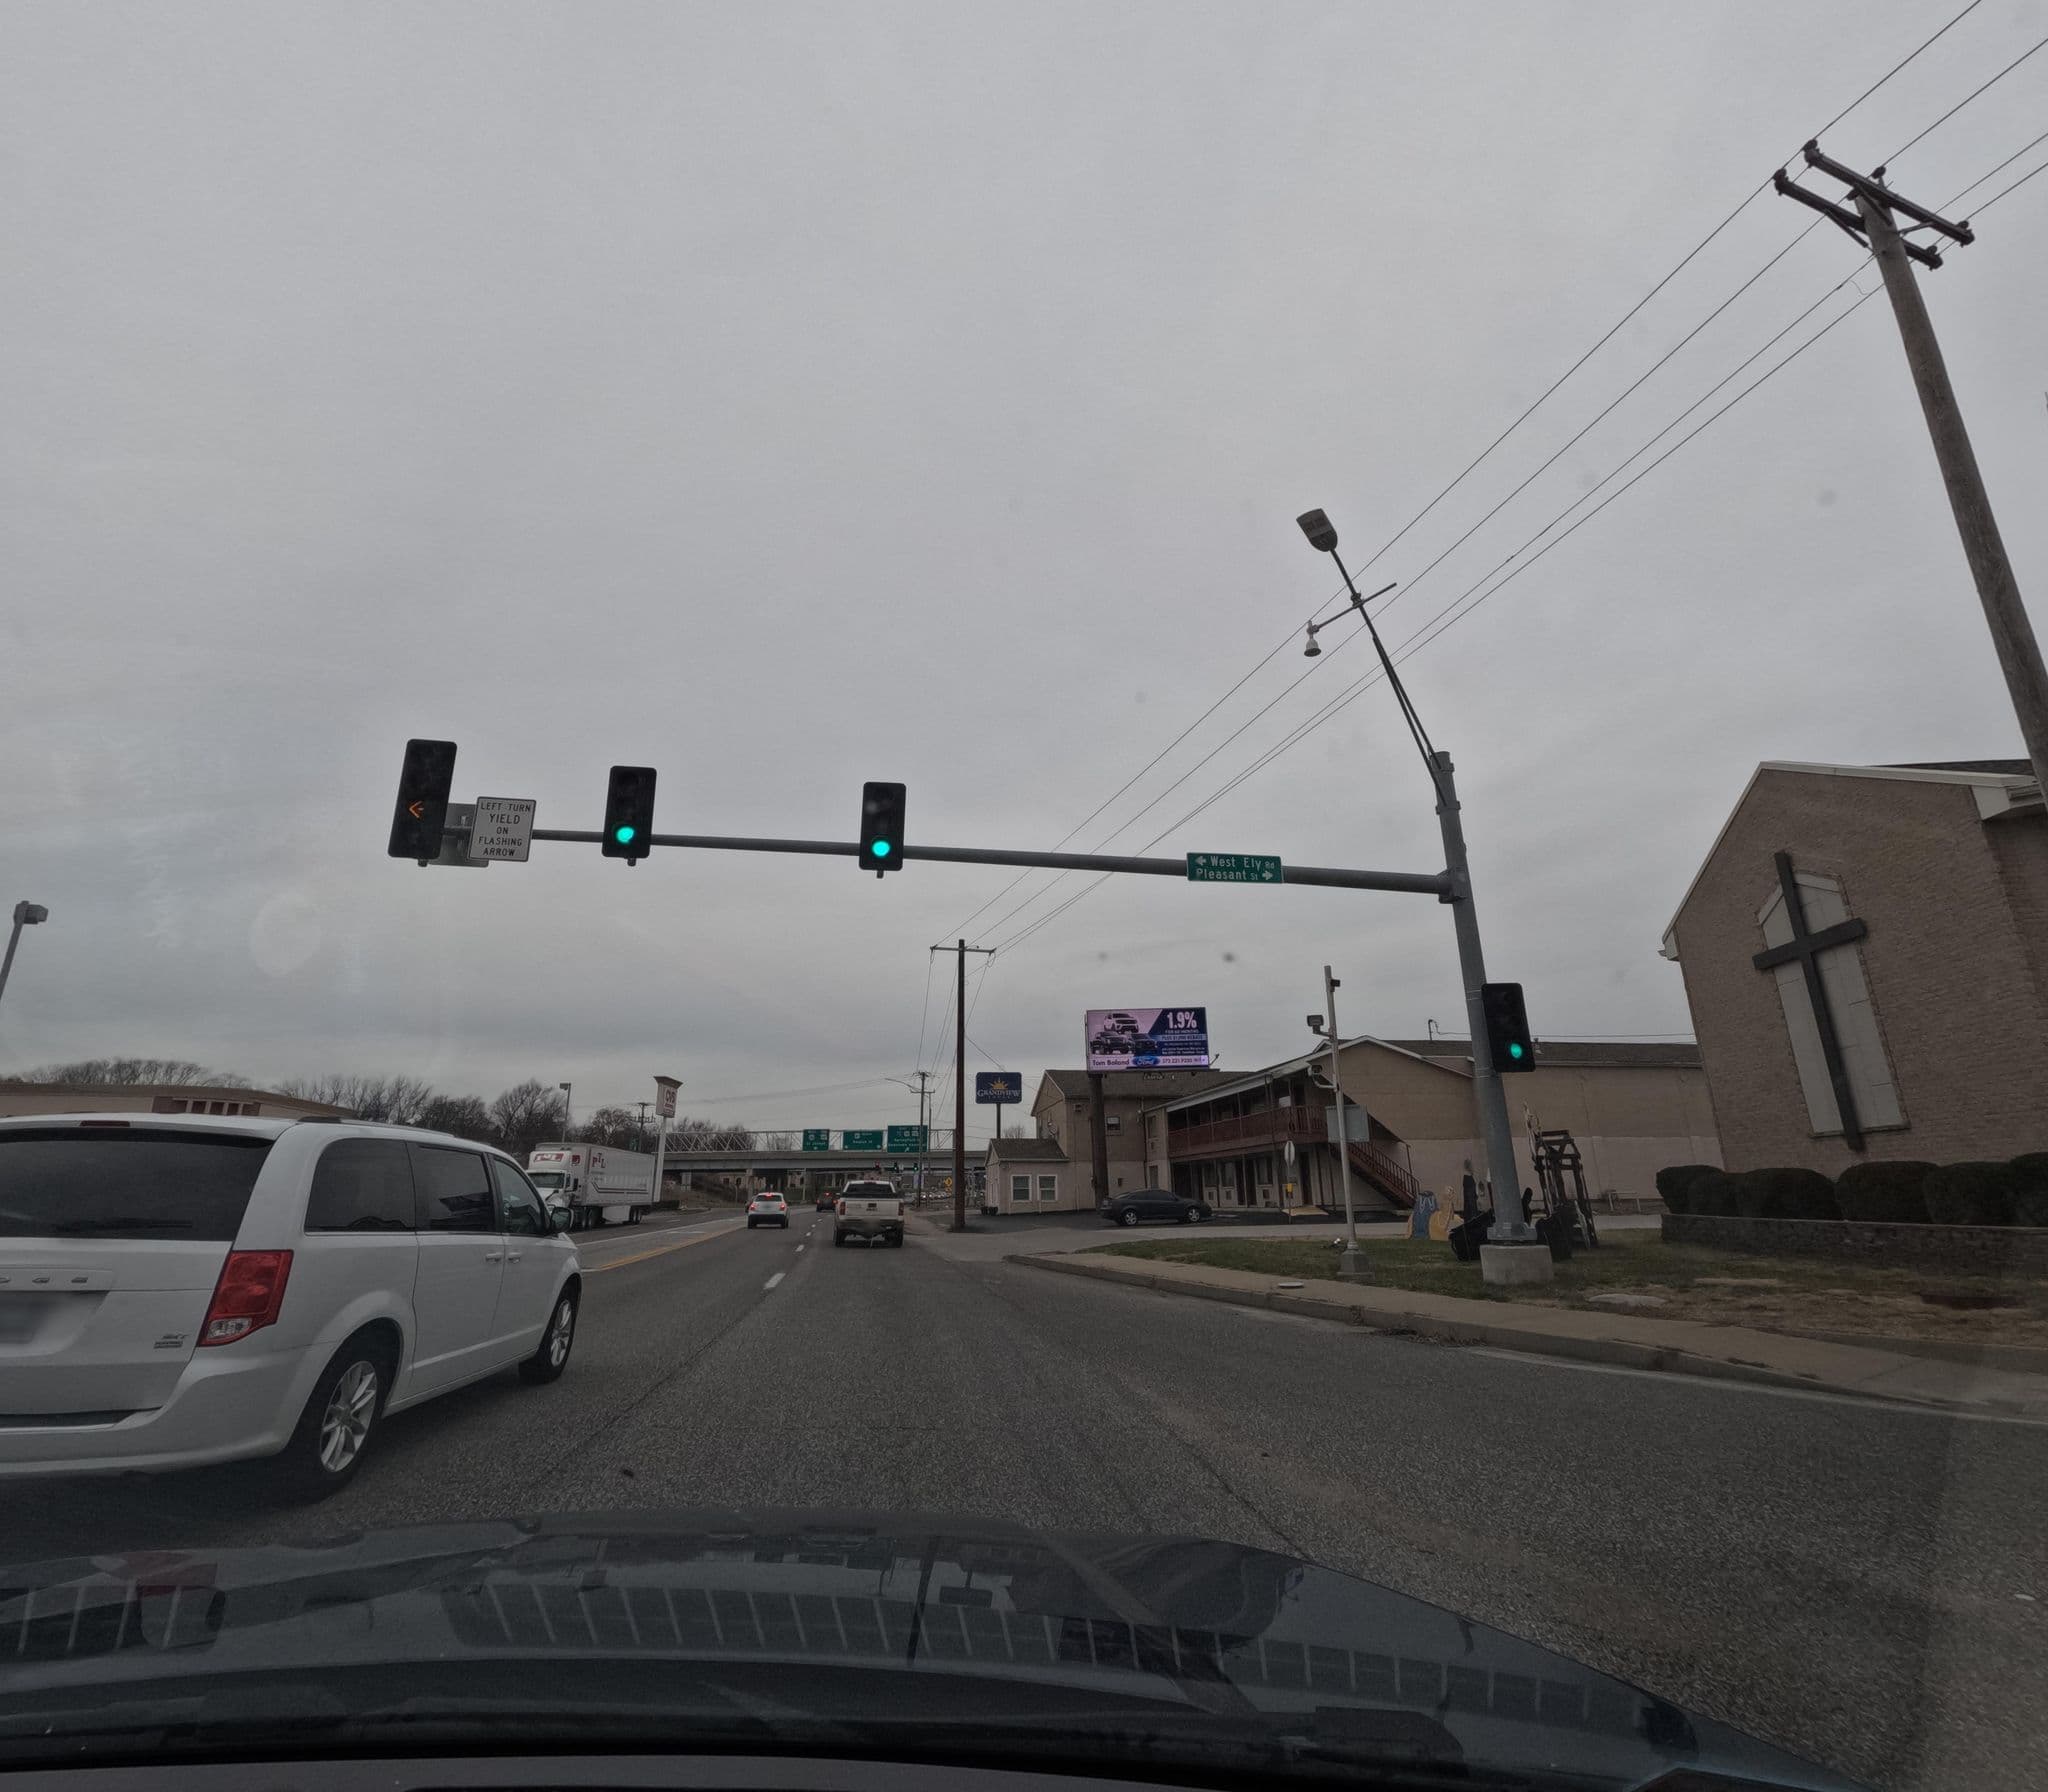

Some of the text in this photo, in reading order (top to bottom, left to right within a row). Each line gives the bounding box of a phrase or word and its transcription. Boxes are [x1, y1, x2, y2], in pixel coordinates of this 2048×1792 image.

[481, 802, 531, 812] LEFT TURN
[489, 813, 520, 824] YIELD
[496, 826, 509, 835] ON
[479, 837, 522, 846] FLASHING
[483, 848, 515, 857] ARROW
[1210, 855, 1236, 867] West
[1243, 857, 1262, 871] Ely
[1196, 868, 1247, 880] Pleasant
[1167, 1011, 1197, 1029] 1.9%
